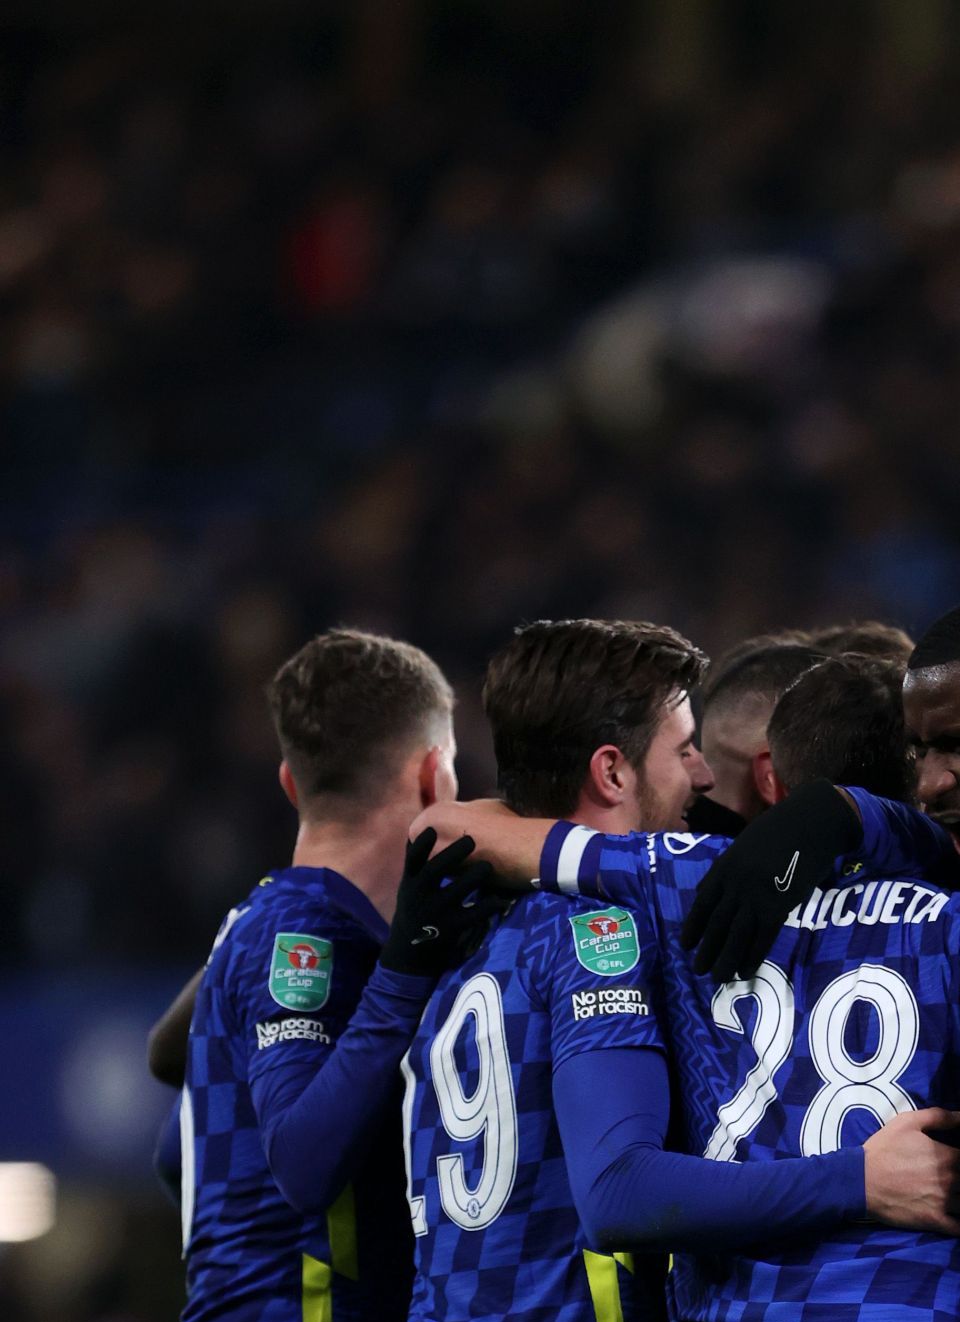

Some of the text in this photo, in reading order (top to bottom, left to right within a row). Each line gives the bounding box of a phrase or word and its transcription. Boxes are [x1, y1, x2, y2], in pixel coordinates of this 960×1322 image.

[580, 930, 633, 950] Carabao
[595, 942, 620, 954] Cup
[275, 967, 328, 979] Carabao
[288, 977, 314, 988] Cup
[572, 989, 642, 1008] No room
[599, 1002, 649, 1016] racism
[256, 1018, 324, 1038] No room
[279, 1028, 331, 1045] racism
[703, 960, 920, 1163] 28
